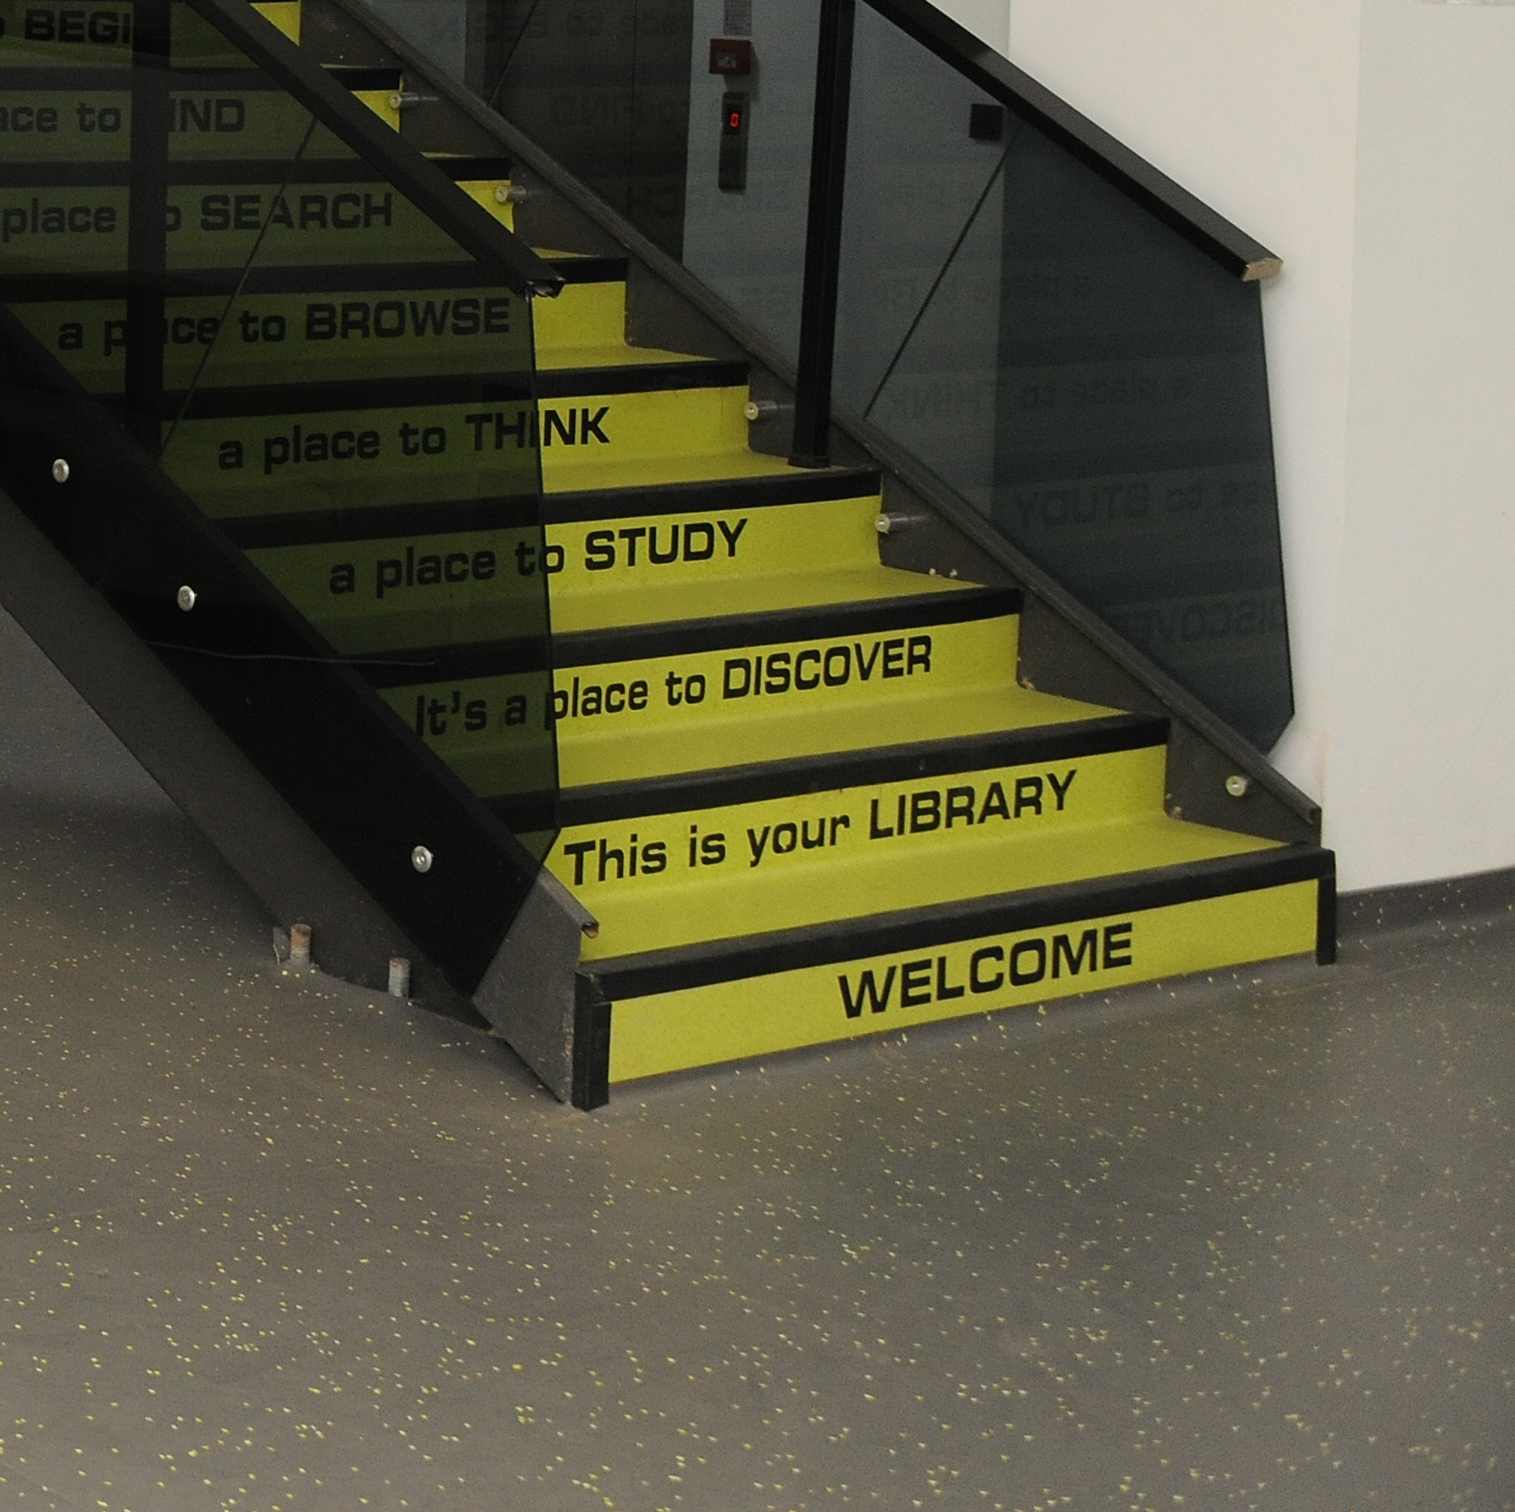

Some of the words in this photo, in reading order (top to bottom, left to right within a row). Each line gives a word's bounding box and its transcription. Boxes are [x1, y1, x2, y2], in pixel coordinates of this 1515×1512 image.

[24, 9, 133, 45] BEGI
[77, 103, 121, 133] to
[168, 98, 245, 134] IND
[3, 197, 117, 243] place
[199, 193, 393, 232] SEARCH
[57, 320, 84, 350] a
[240, 310, 287, 345] to
[305, 296, 511, 341] BROWSE
[218, 438, 244, 470] a
[264, 426, 380, 475] place
[399, 422, 447, 456] to
[465, 407, 609, 452] THINK
[329, 562, 355, 595] a
[377, 547, 496, 599] place
[515, 541, 564, 575] to
[585, 519, 747, 571] STUDY
[415, 691, 488, 737] It's
[504, 696, 528, 726] a
[545, 678, 648, 732] place
[666, 671, 706, 706] to
[722, 634, 933, 700] DISCOVER
[563, 833, 668, 886] This
[688, 824, 727, 867] is
[747, 812, 850, 867] your
[869, 769, 1078, 841] LIBRARY
[837, 922, 1134, 1020] WELCOME
